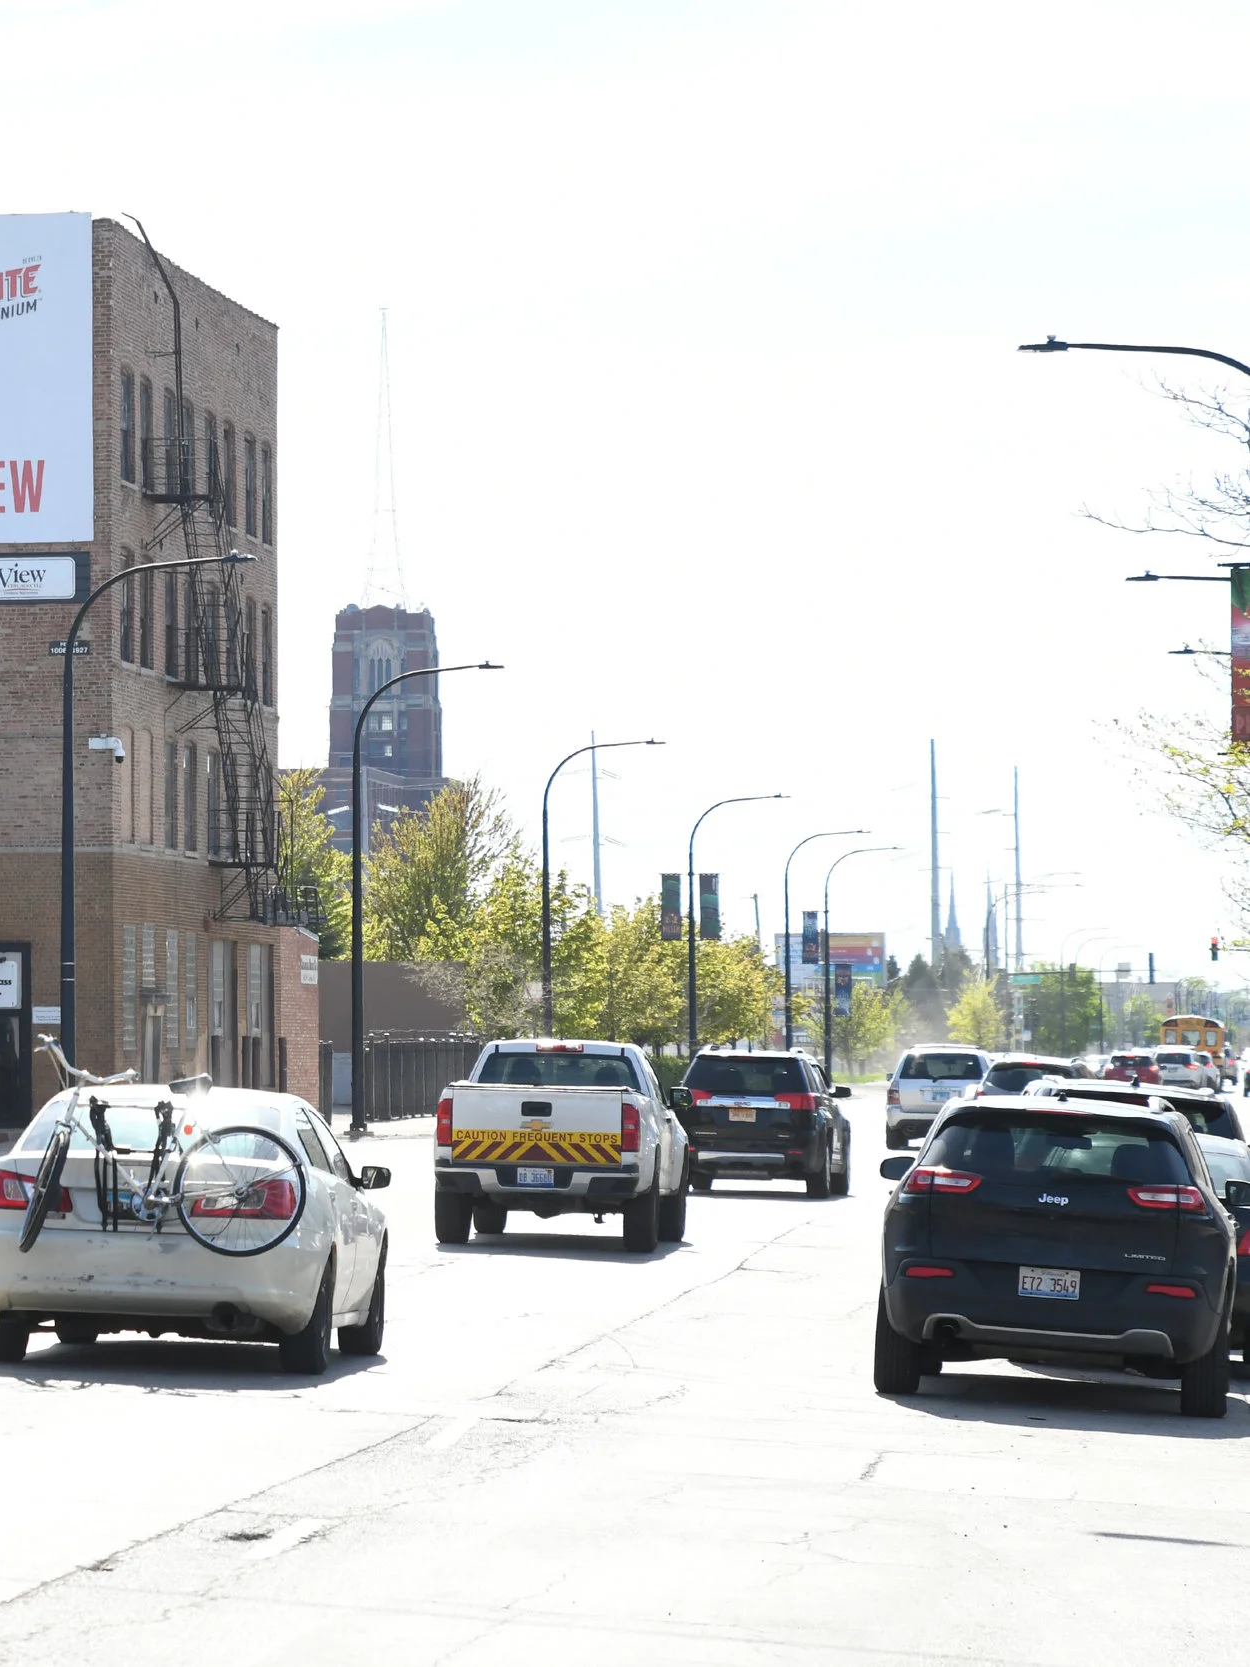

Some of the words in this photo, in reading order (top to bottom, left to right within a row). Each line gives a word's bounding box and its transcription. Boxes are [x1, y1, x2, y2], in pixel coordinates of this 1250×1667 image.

[456, 1131, 507, 1141] CAUTION
[512, 1132, 574, 1143] FREQUENT
[579, 1133, 618, 1144] STOPS
[1038, 1193, 1069, 1206] Jeep
[1124, 1253, 1166, 1261] LIMITED
[1022, 1275, 1043, 1291] E72
[1050, 1278, 1077, 1294] 3549
